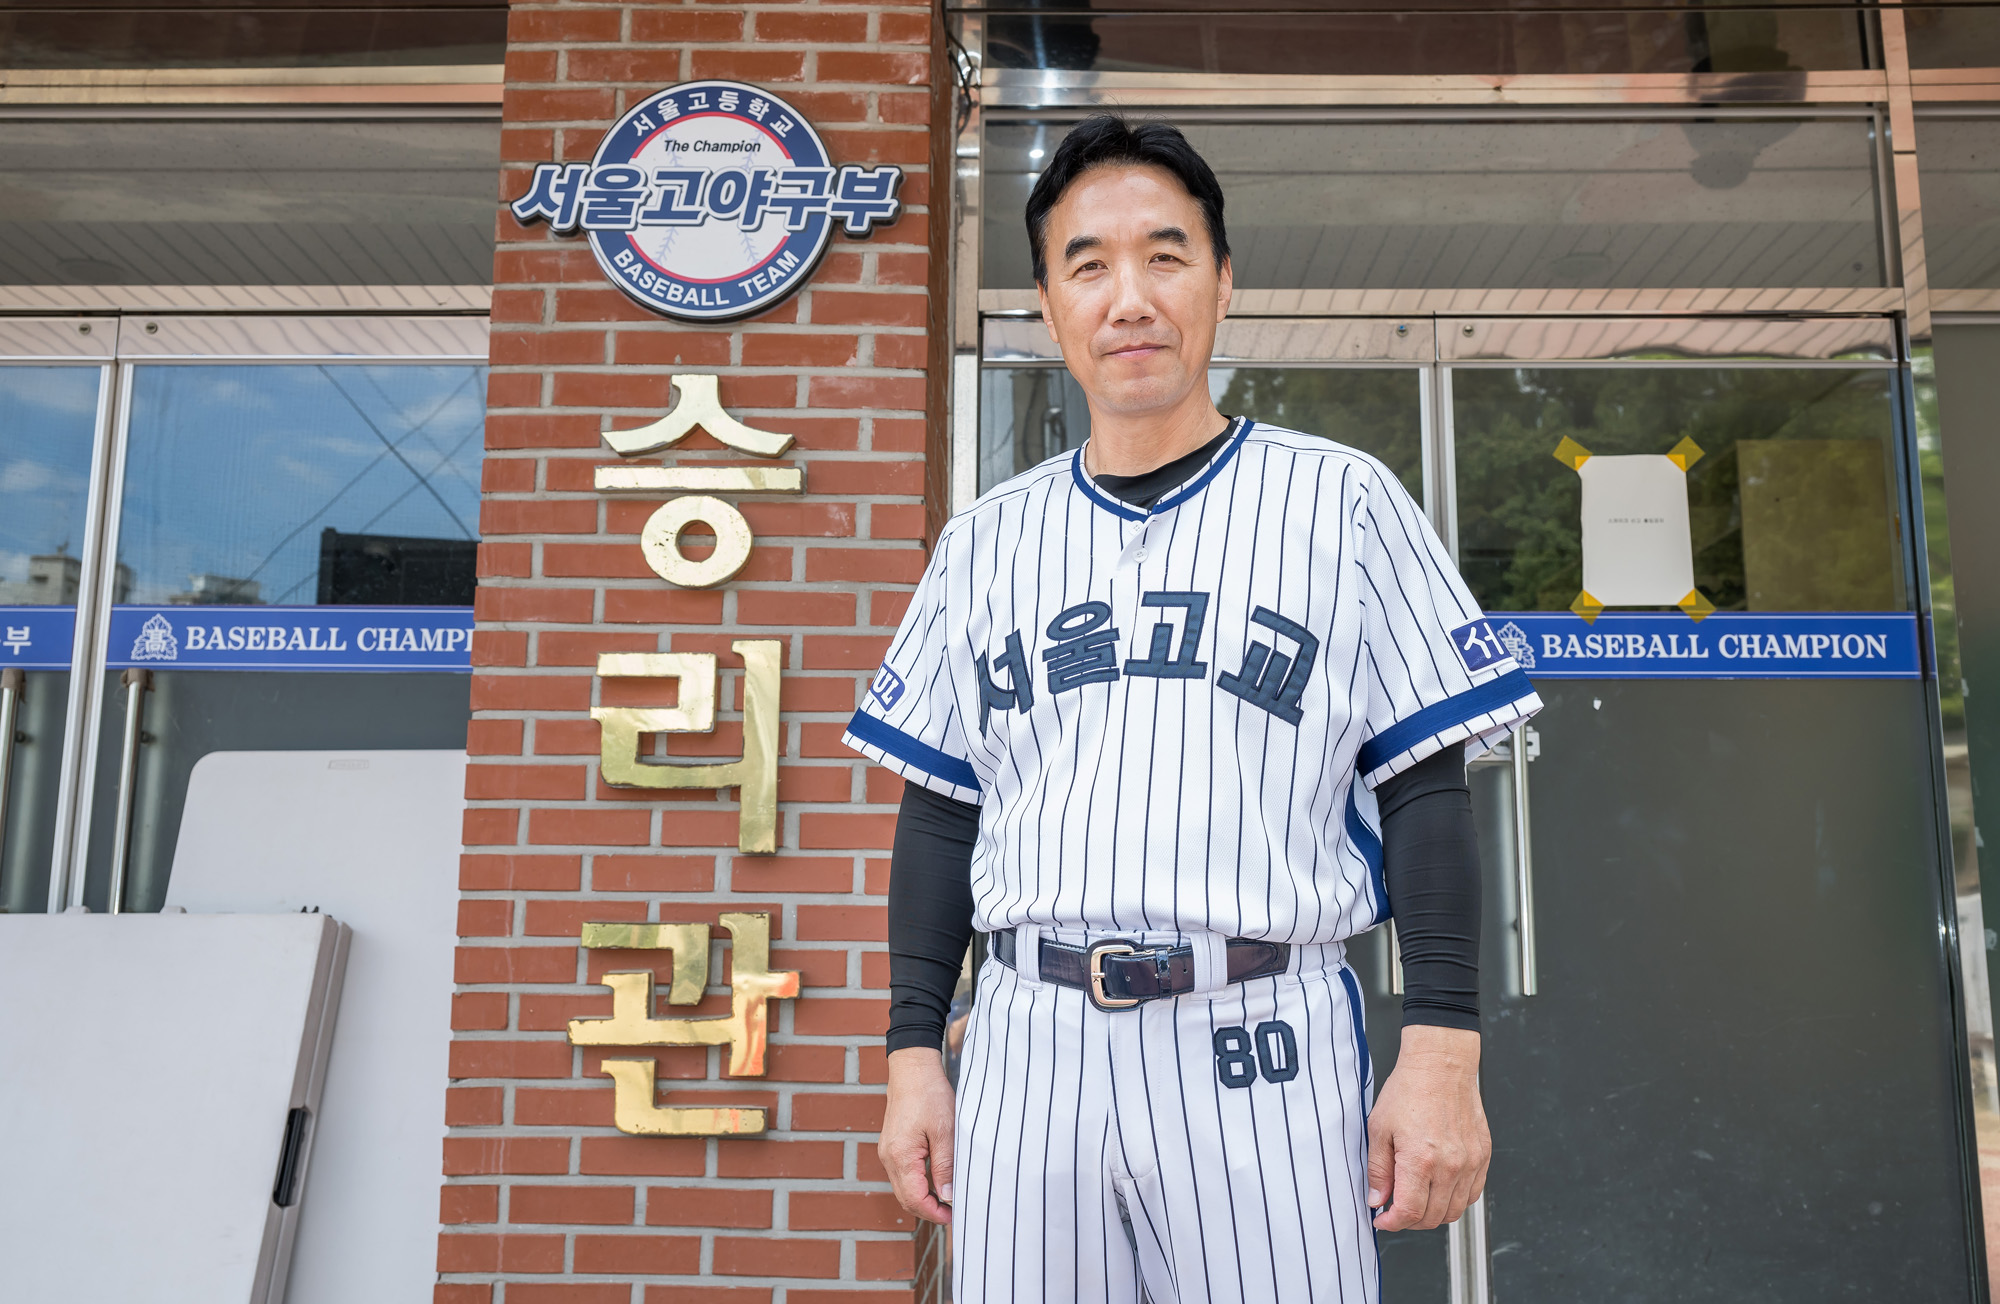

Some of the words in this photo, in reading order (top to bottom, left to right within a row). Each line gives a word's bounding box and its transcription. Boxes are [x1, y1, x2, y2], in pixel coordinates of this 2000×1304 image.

[632, 90, 795, 138] 서울고등학교
[664, 140, 690, 153] The
[693, 140, 761, 154] Champion
[512, 164, 901, 231] 서울고야구부
[613, 248, 730, 306] BASEBALL
[738, 249, 800, 299] TEAM
[184, 626, 347, 652] BASEBALL
[975, 591, 1320, 740] 서울고교
[1541, 633, 1709, 659] BASEBALL
[1718, 633, 1887, 659] CHAMPION
[1213, 1020, 1299, 1089] 80
